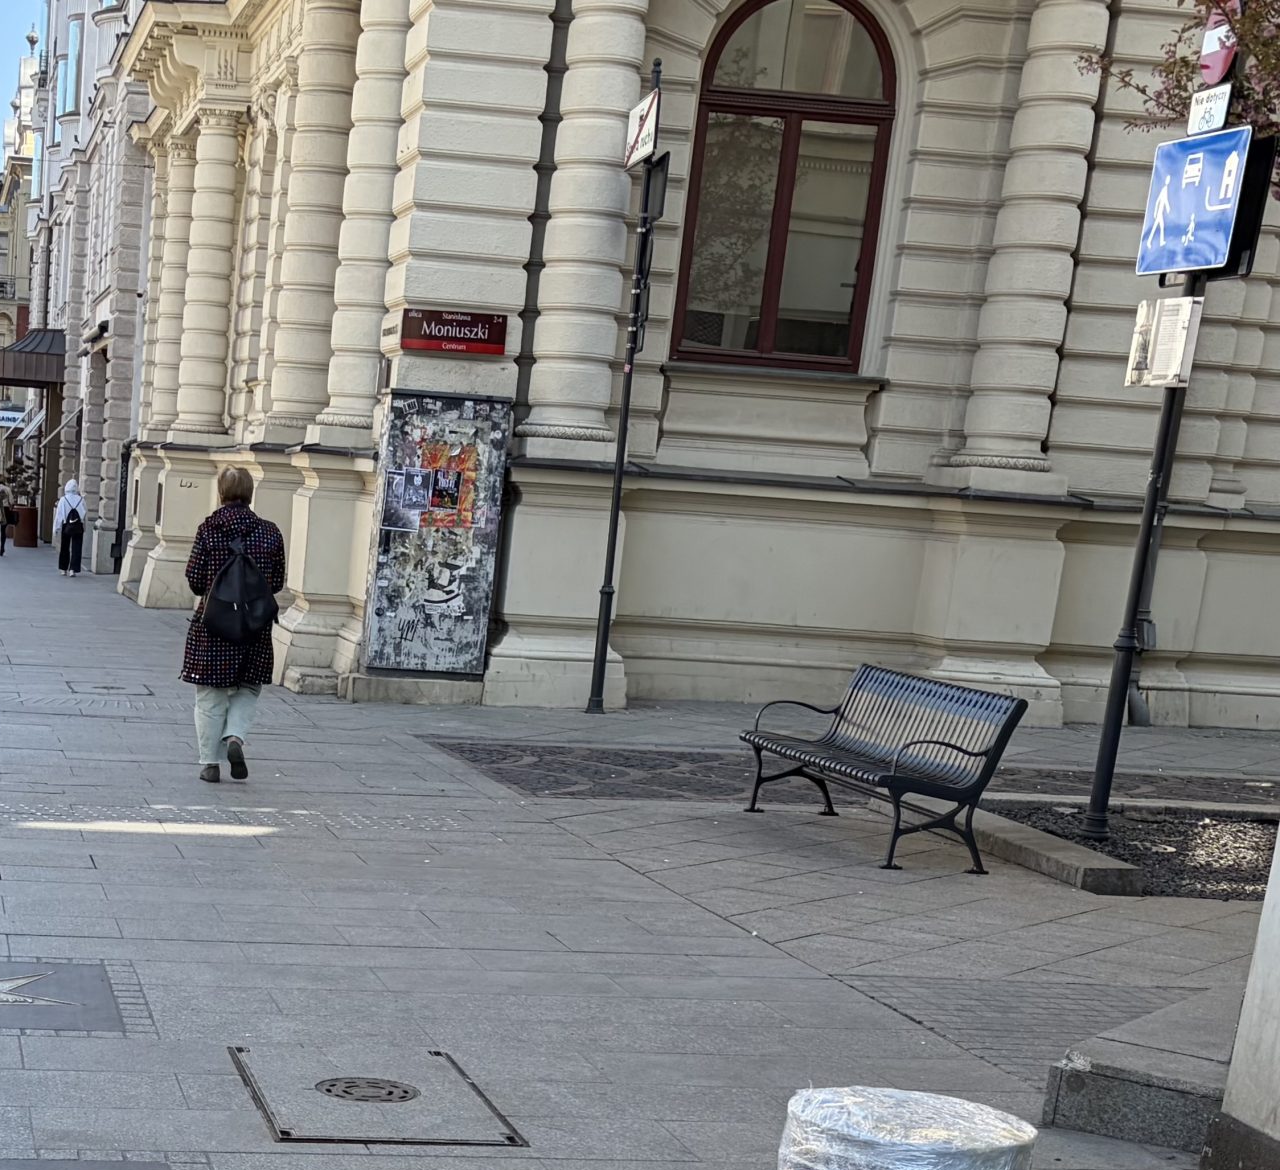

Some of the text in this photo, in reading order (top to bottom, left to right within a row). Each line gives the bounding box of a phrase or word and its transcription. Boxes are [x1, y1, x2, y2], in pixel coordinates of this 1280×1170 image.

[408, 310, 422, 318] ulica
[421, 320, 489, 339] Moniuszki
[441, 342, 466, 350] Centrum
